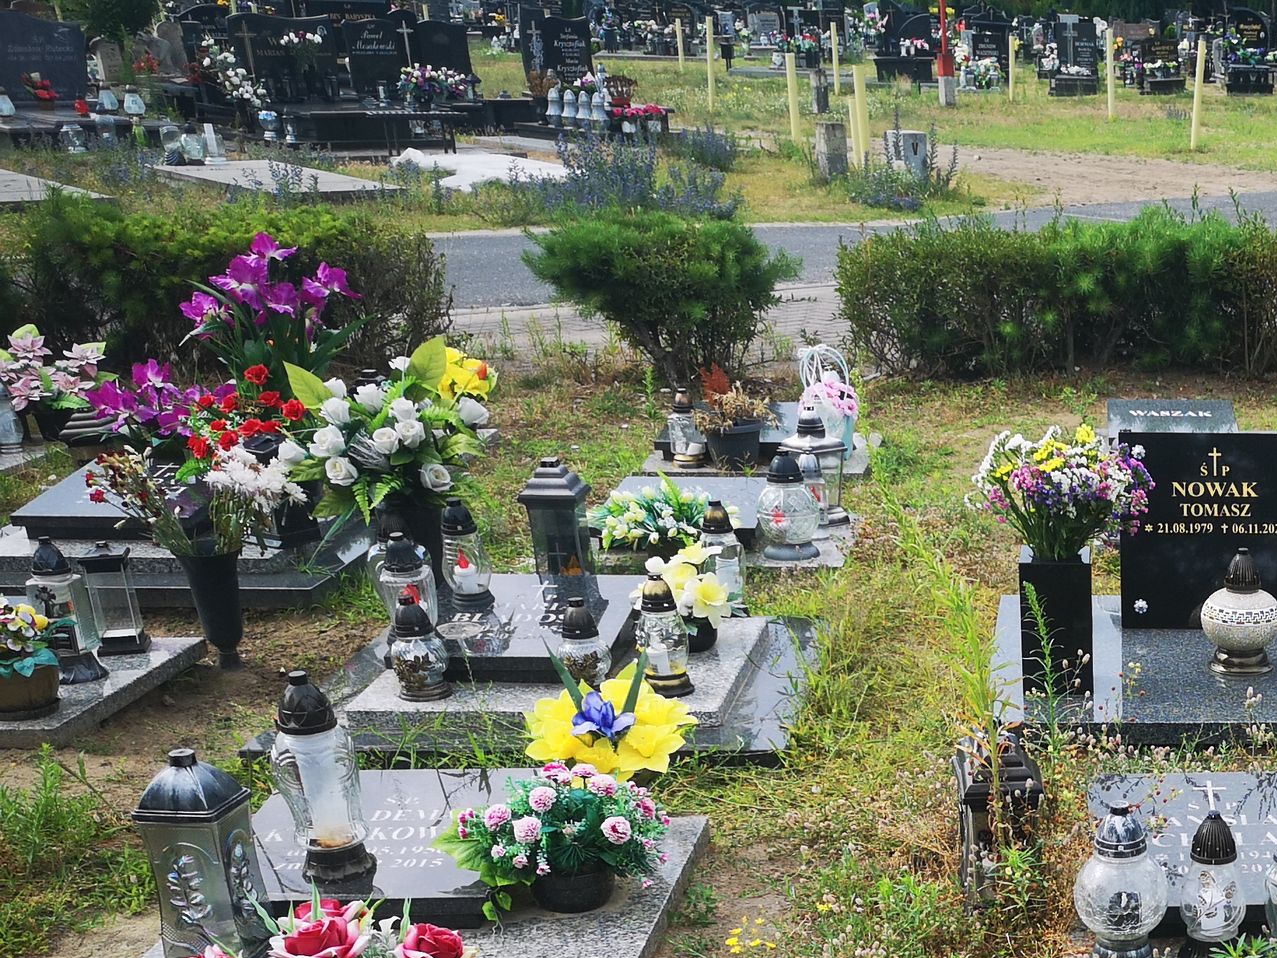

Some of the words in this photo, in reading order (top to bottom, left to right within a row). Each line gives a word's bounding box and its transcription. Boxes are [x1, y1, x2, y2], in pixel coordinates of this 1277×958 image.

[1200, 462, 1208, 476] Ś
[1221, 466, 1230, 476] P
[1171, 482, 1258, 498] NOWAK
[1180, 503, 1251, 517] TOMASZ
[1157, 522, 1214, 534] 21.08.1979
